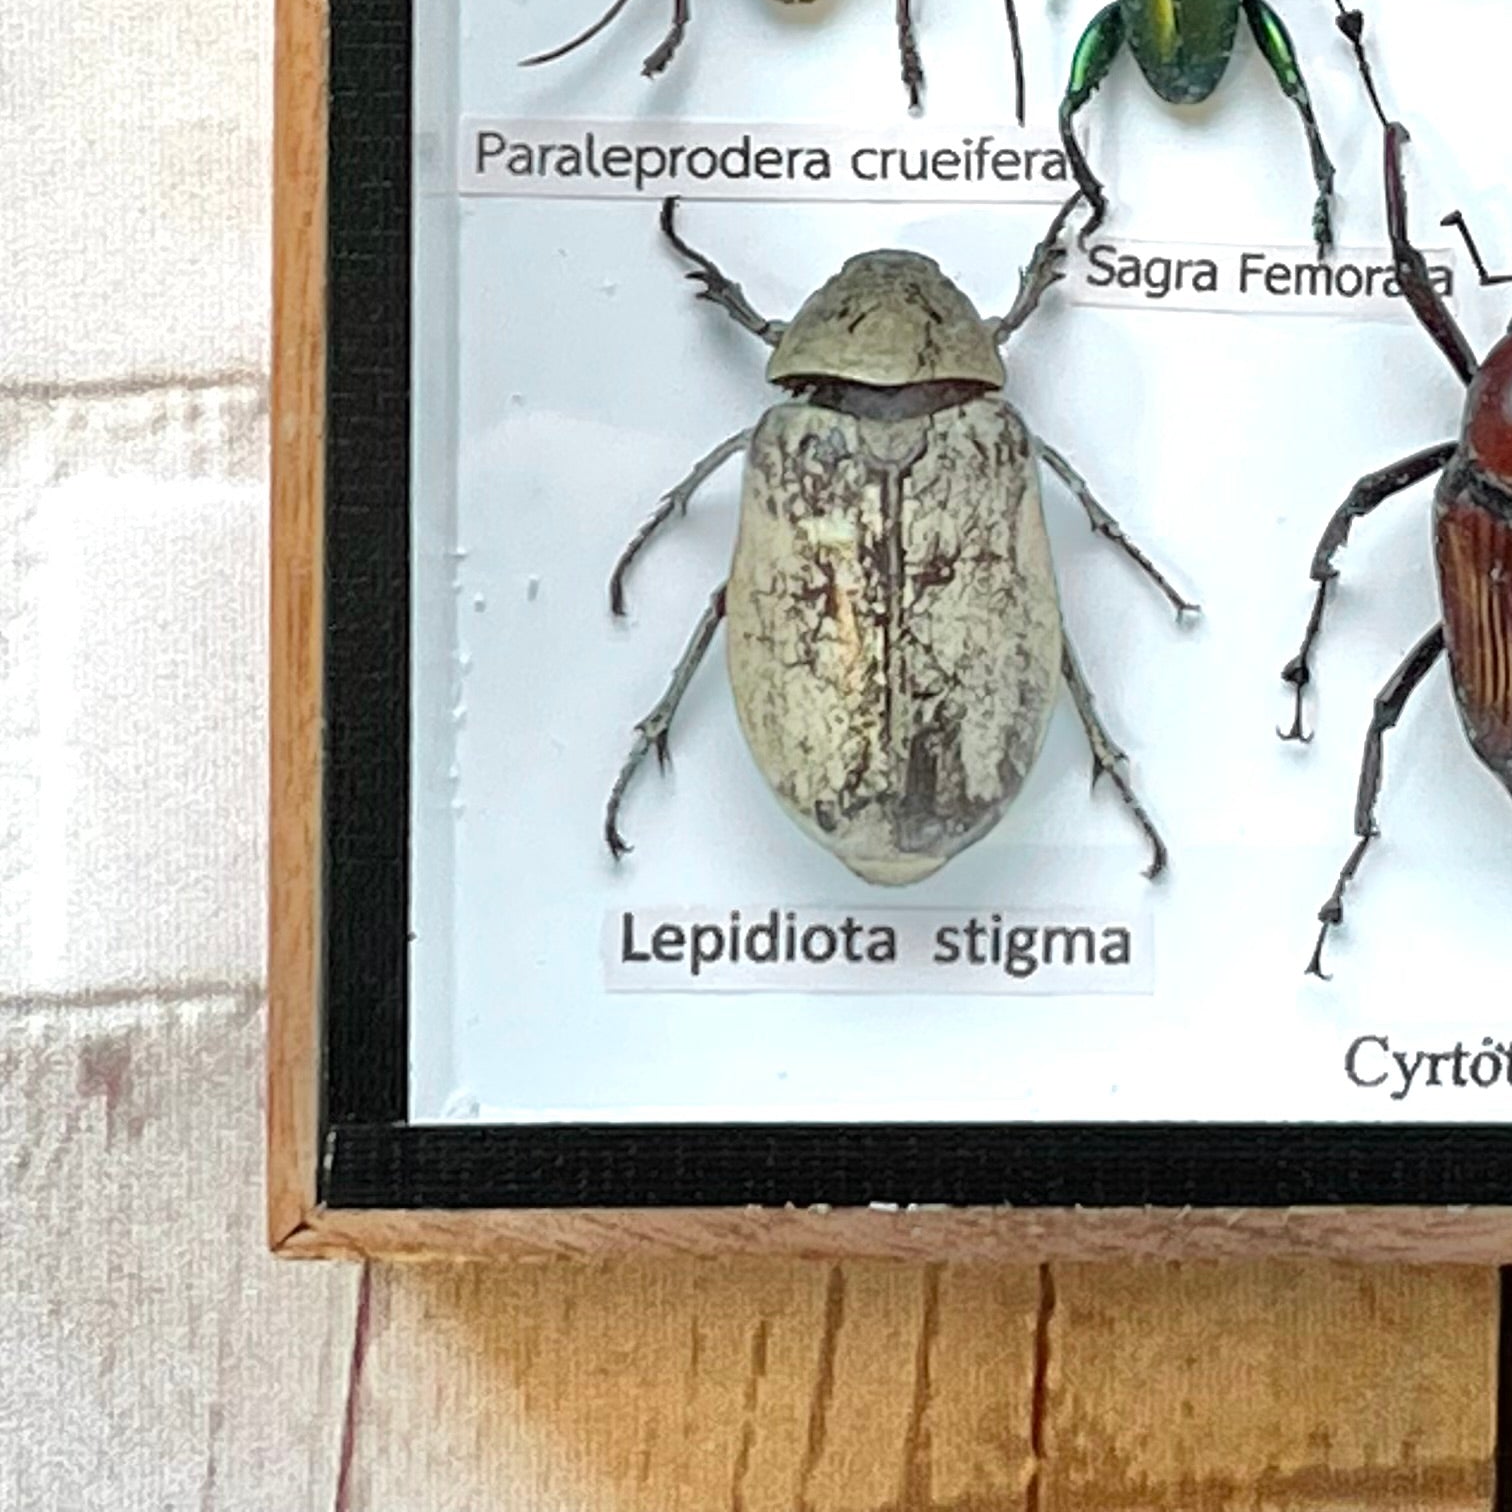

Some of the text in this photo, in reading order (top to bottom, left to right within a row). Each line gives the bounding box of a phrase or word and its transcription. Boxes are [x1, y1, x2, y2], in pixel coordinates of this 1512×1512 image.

[475, 130, 1067, 189] Paraleprodera crueifera
[1087, 244, 1454, 299] Sagra Femoraa
[621, 911, 1131, 979] Lepidiota stigma
